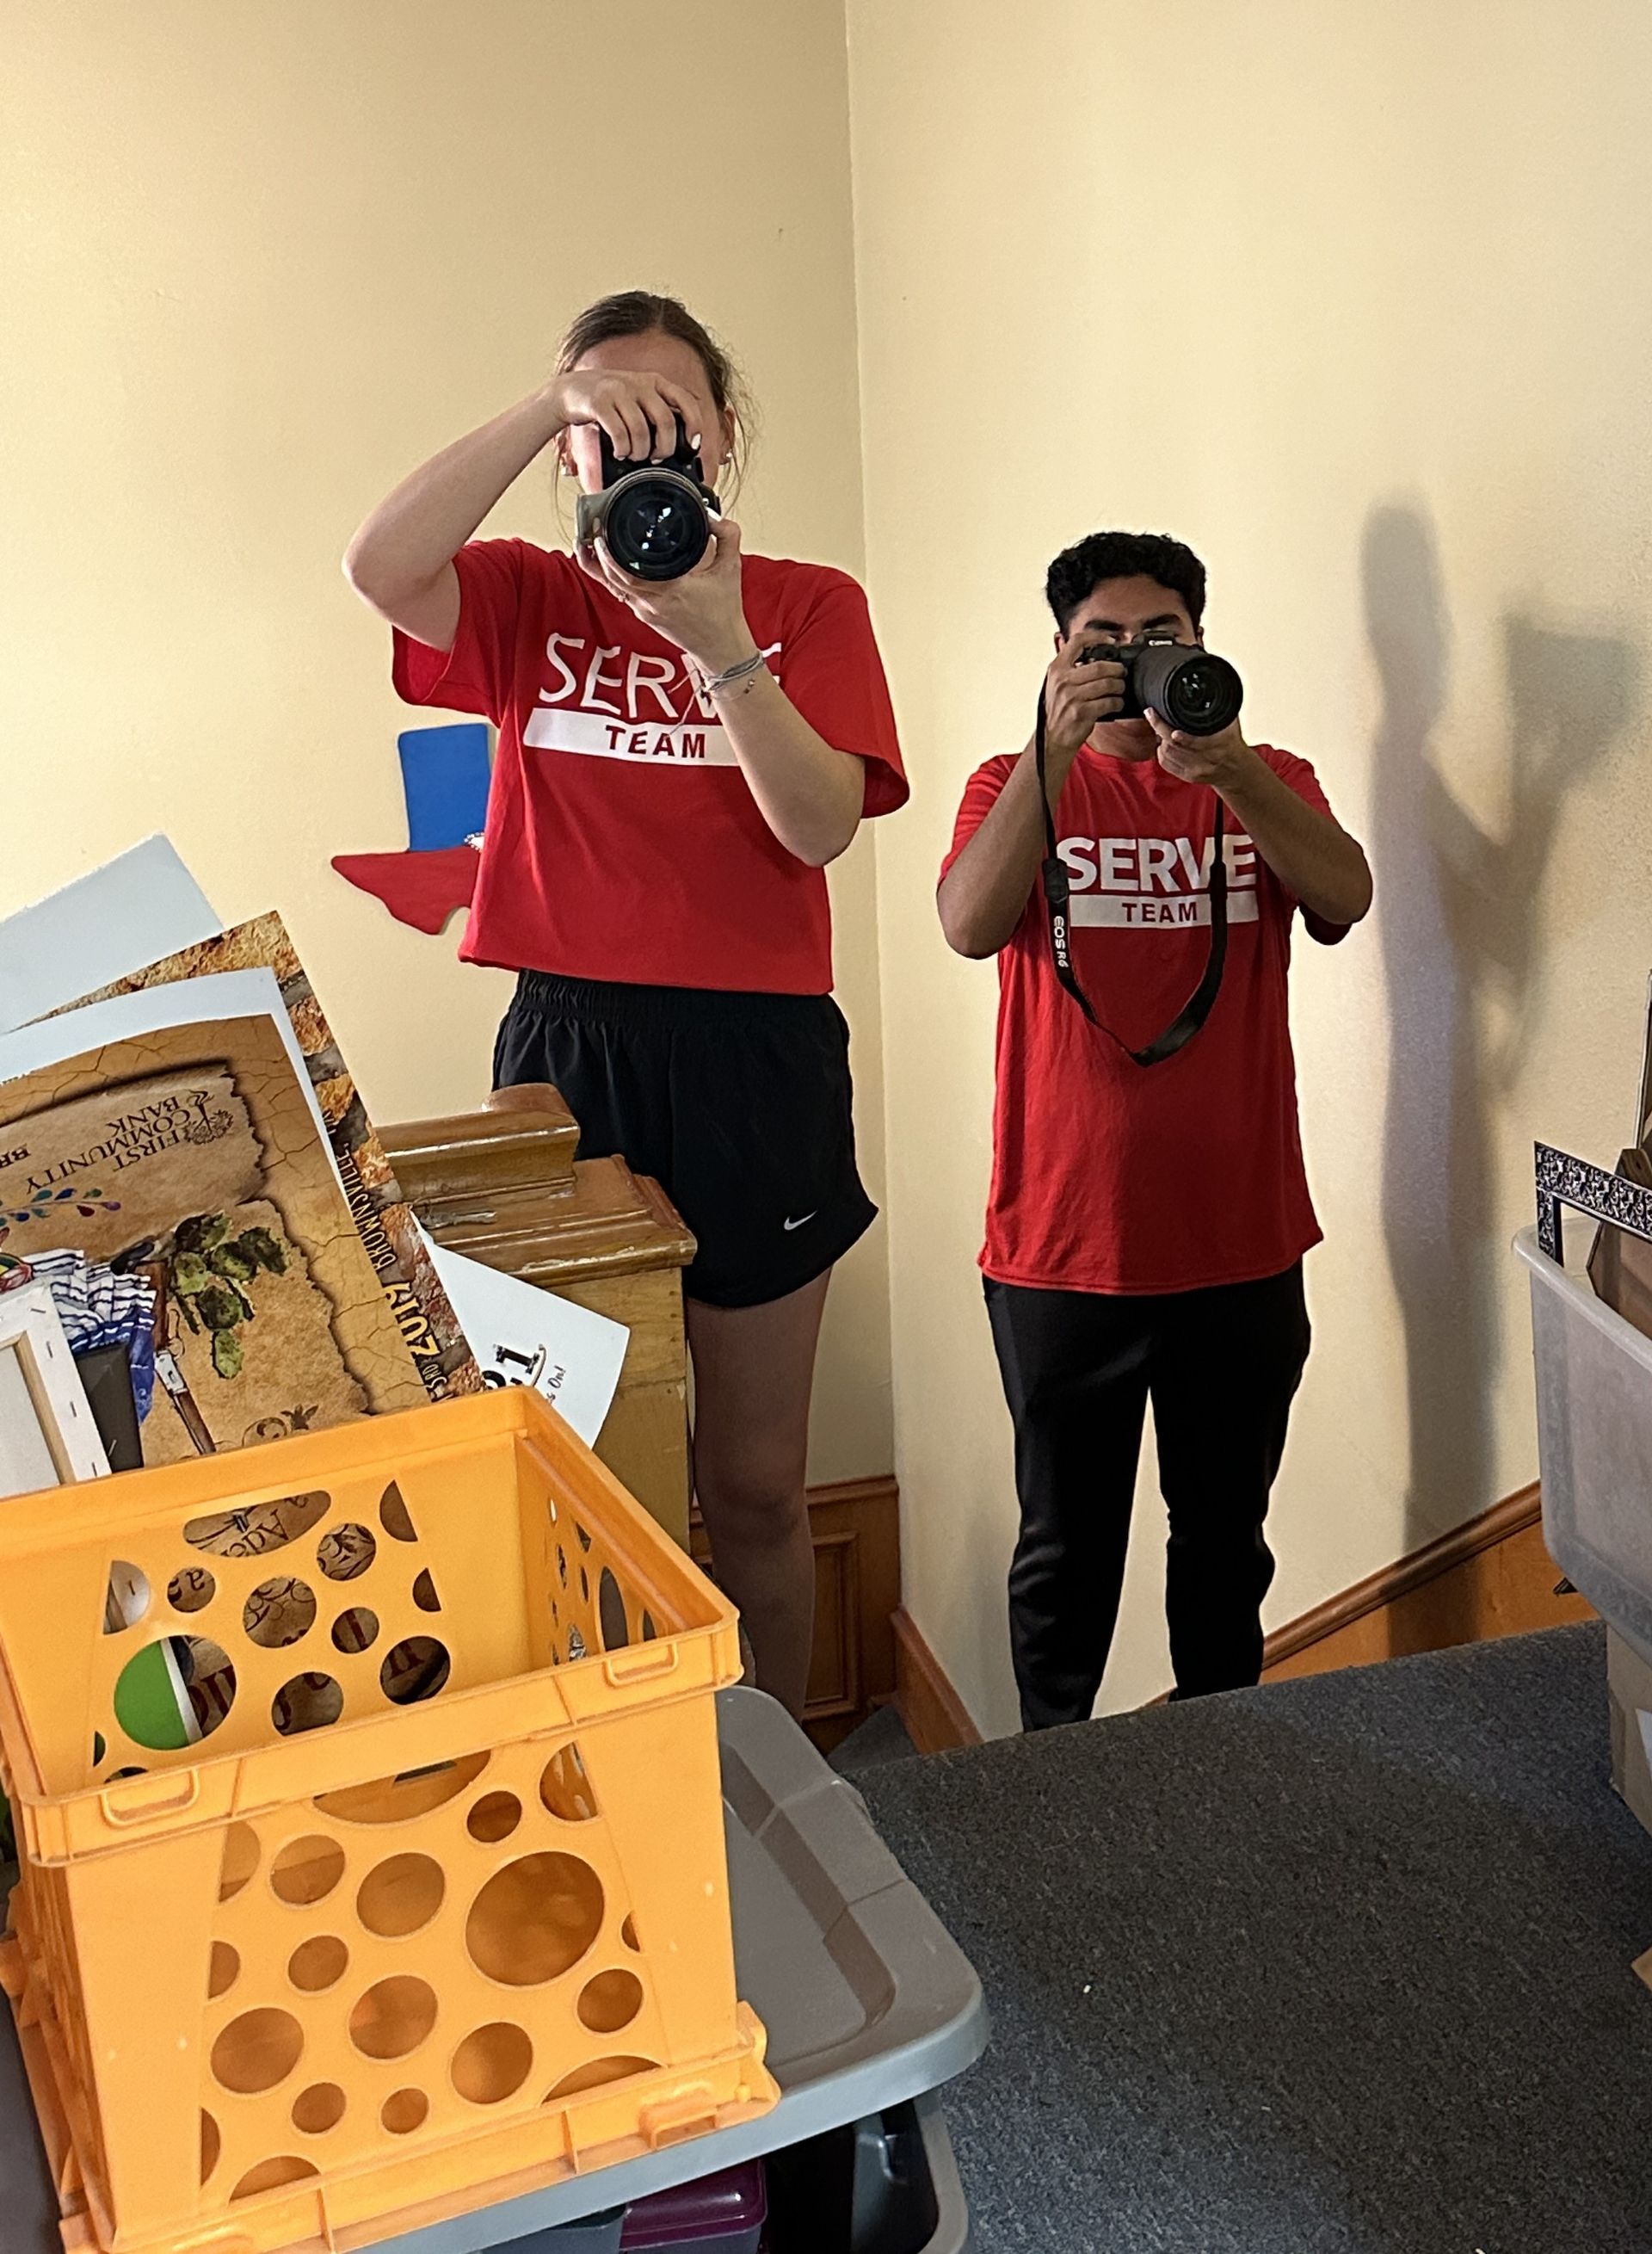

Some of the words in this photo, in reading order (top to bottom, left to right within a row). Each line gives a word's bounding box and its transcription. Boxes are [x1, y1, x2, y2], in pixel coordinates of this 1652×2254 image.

[539, 632, 782, 719] SERV
[605, 725, 706, 758] TEAM
[1056, 834, 1257, 892] SERVE
[1053, 916, 1066, 949] EOS
[1122, 902, 1198, 923] TEAM
[107, 1096, 181, 1137] BANK
[25, 1109, 191, 1195] COMMUNITY
[113, 1129, 181, 1173] FIRST
